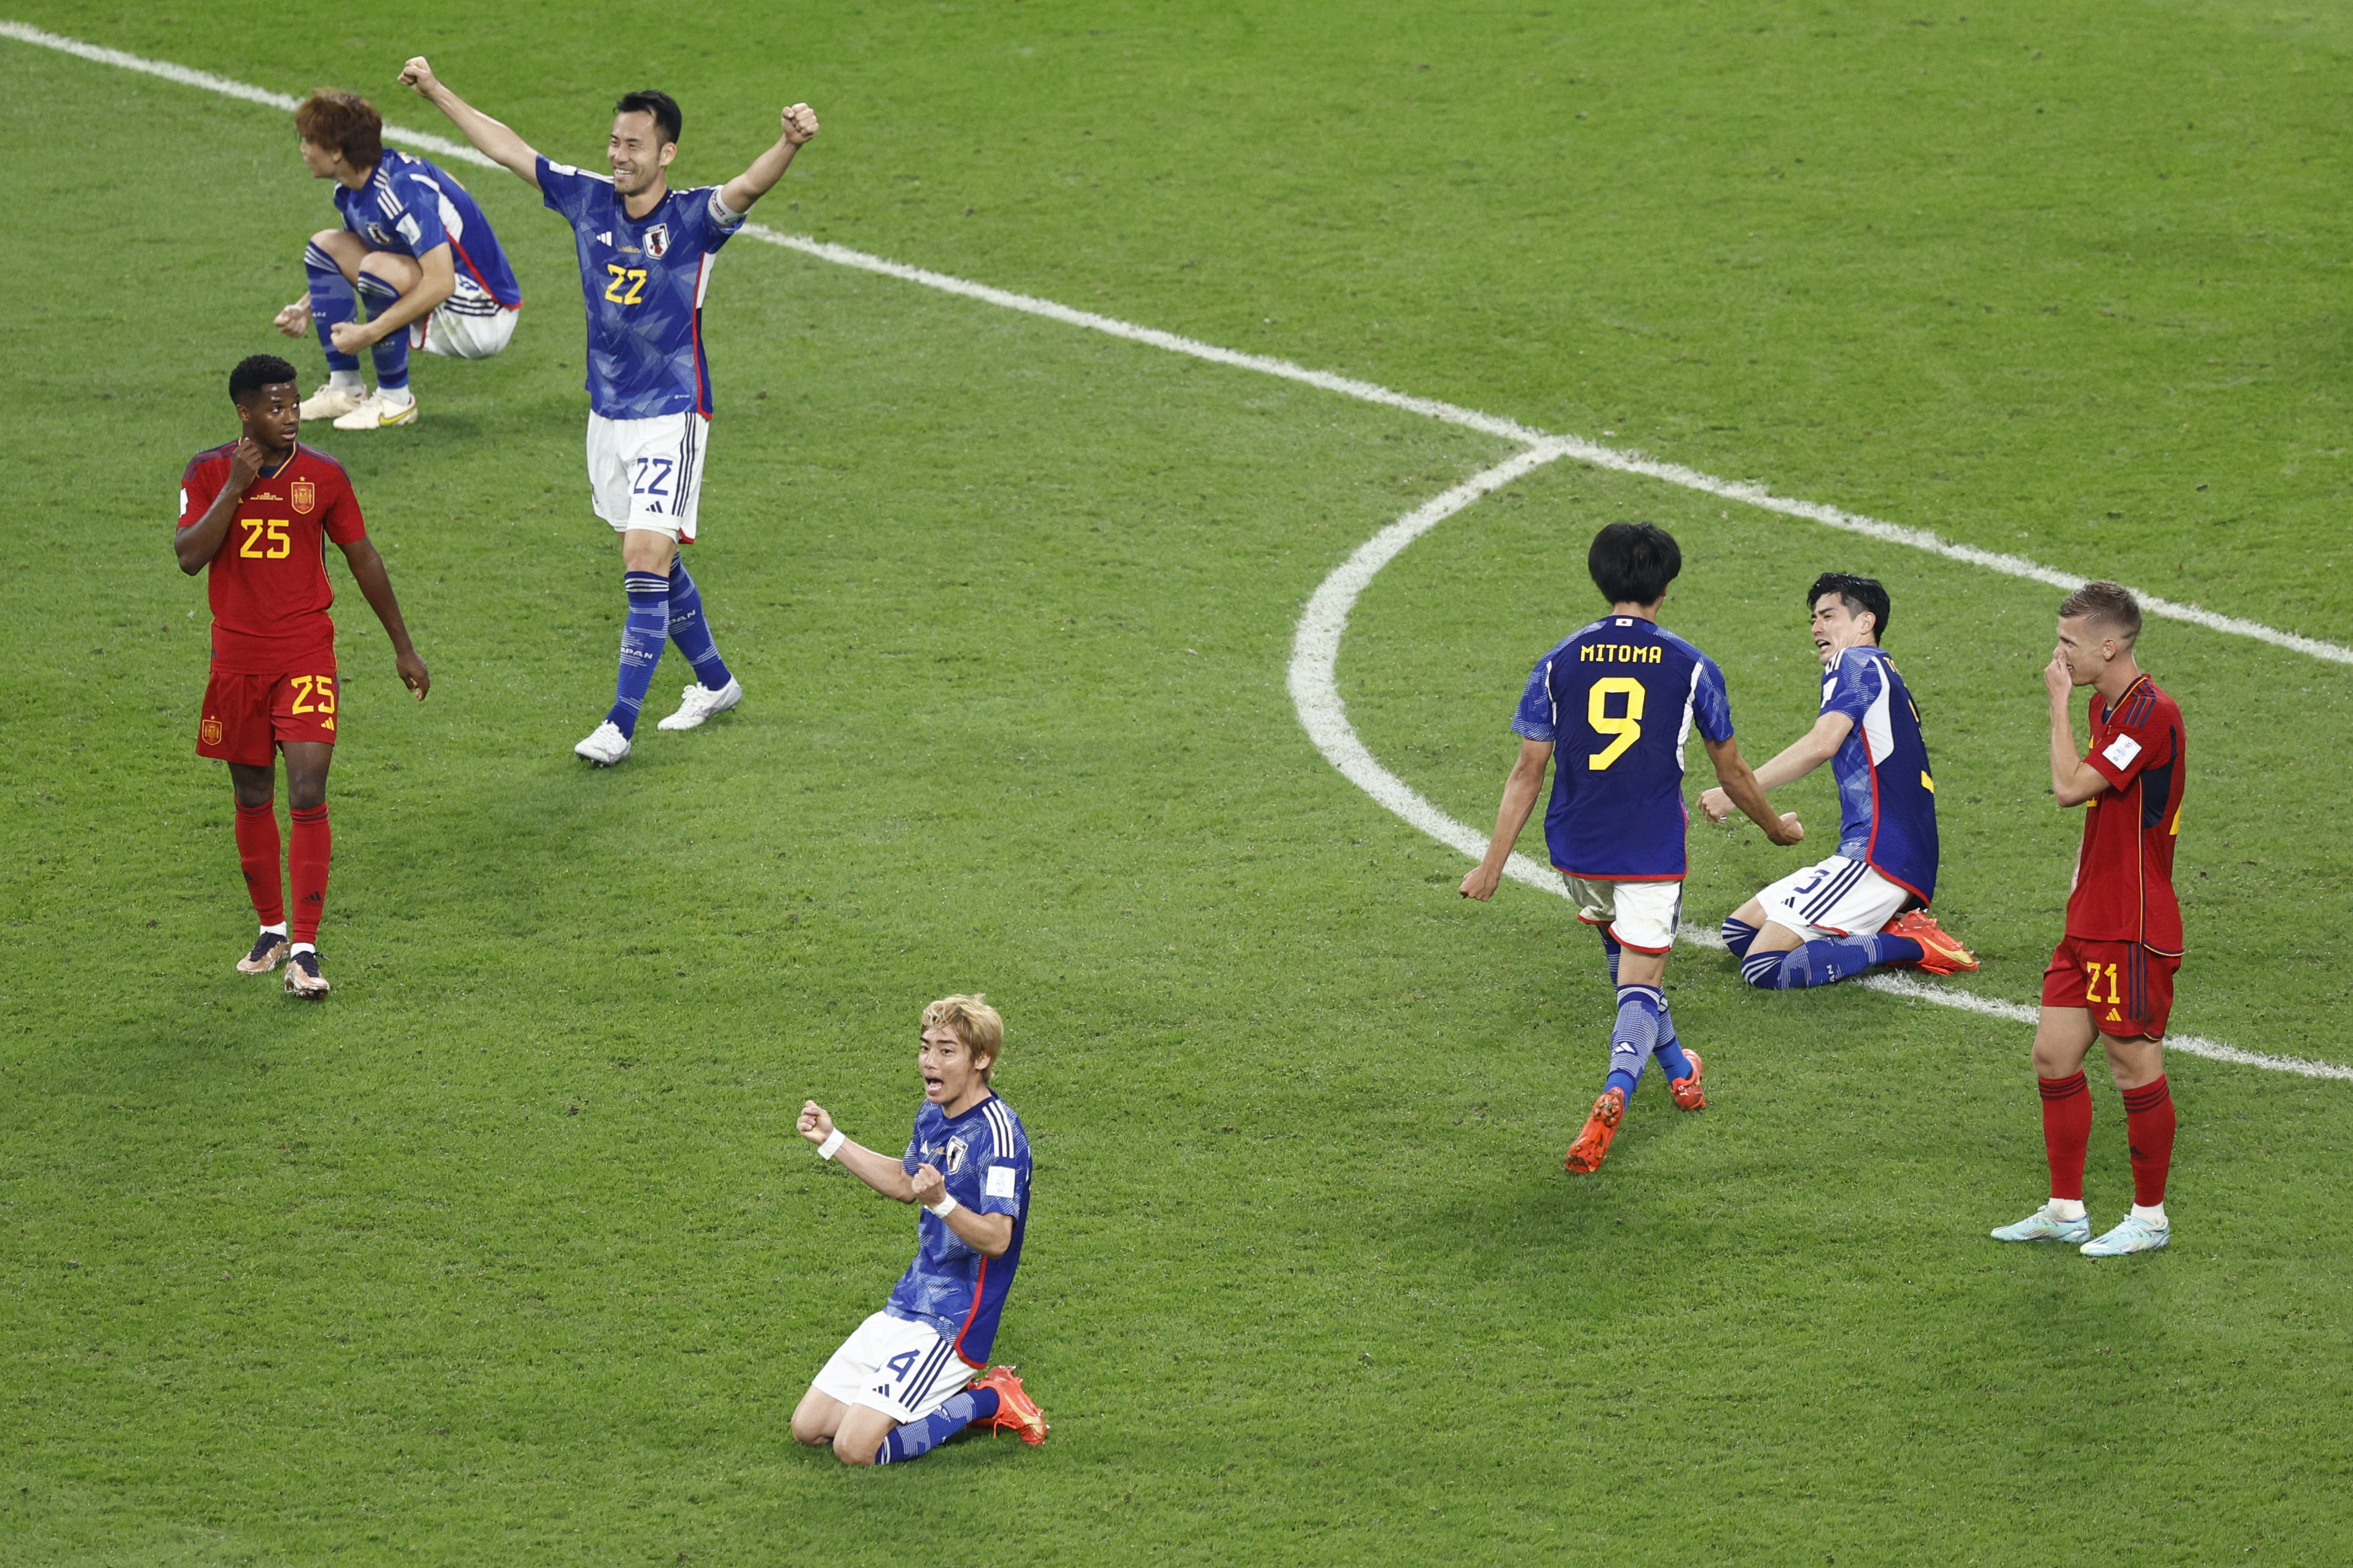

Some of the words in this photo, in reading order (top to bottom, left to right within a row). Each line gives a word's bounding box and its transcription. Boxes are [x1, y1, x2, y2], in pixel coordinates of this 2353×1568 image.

[605, 263, 647, 305] 22
[633, 457, 673, 496] 22
[240, 519, 291, 559] 25
[669, 609, 696, 625] PAN
[1580, 644, 1662, 663] MITOMA
[291, 675, 335, 716] 25
[1588, 677, 1646, 770] 9
[2086, 962, 2120, 1004] 21
[874, 1349, 921, 1383] 4
